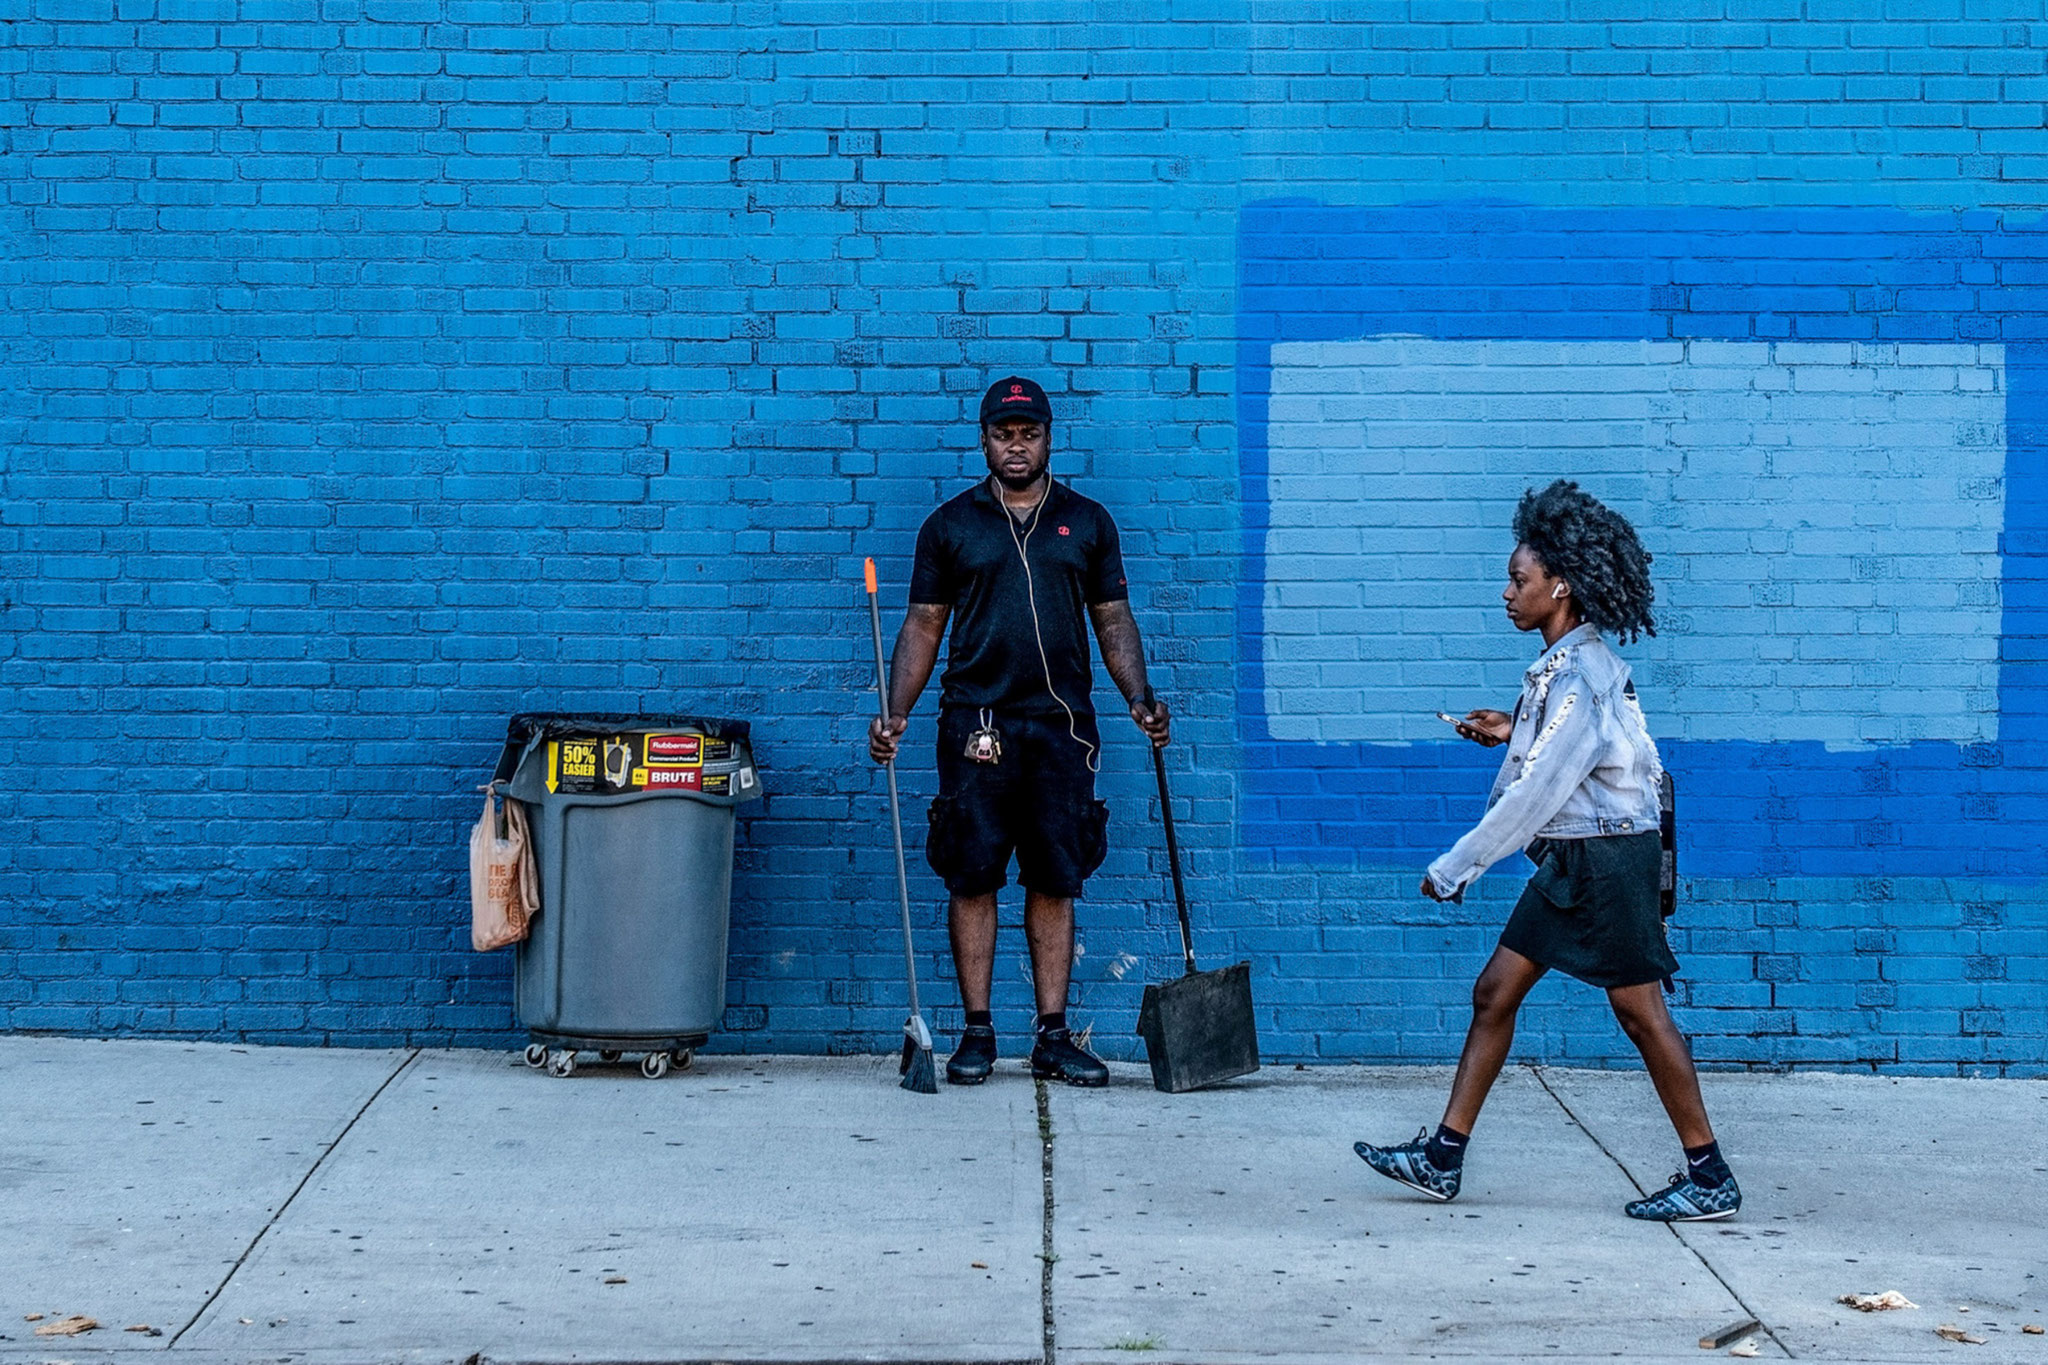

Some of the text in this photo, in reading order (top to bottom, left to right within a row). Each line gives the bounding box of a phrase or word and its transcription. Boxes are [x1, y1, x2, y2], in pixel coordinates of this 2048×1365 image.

[652, 741, 698, 749] Rubbermaid
[563, 745, 596, 764] 50%
[563, 763, 595, 776] EASIER
[651, 772, 695, 783] BRUTE
